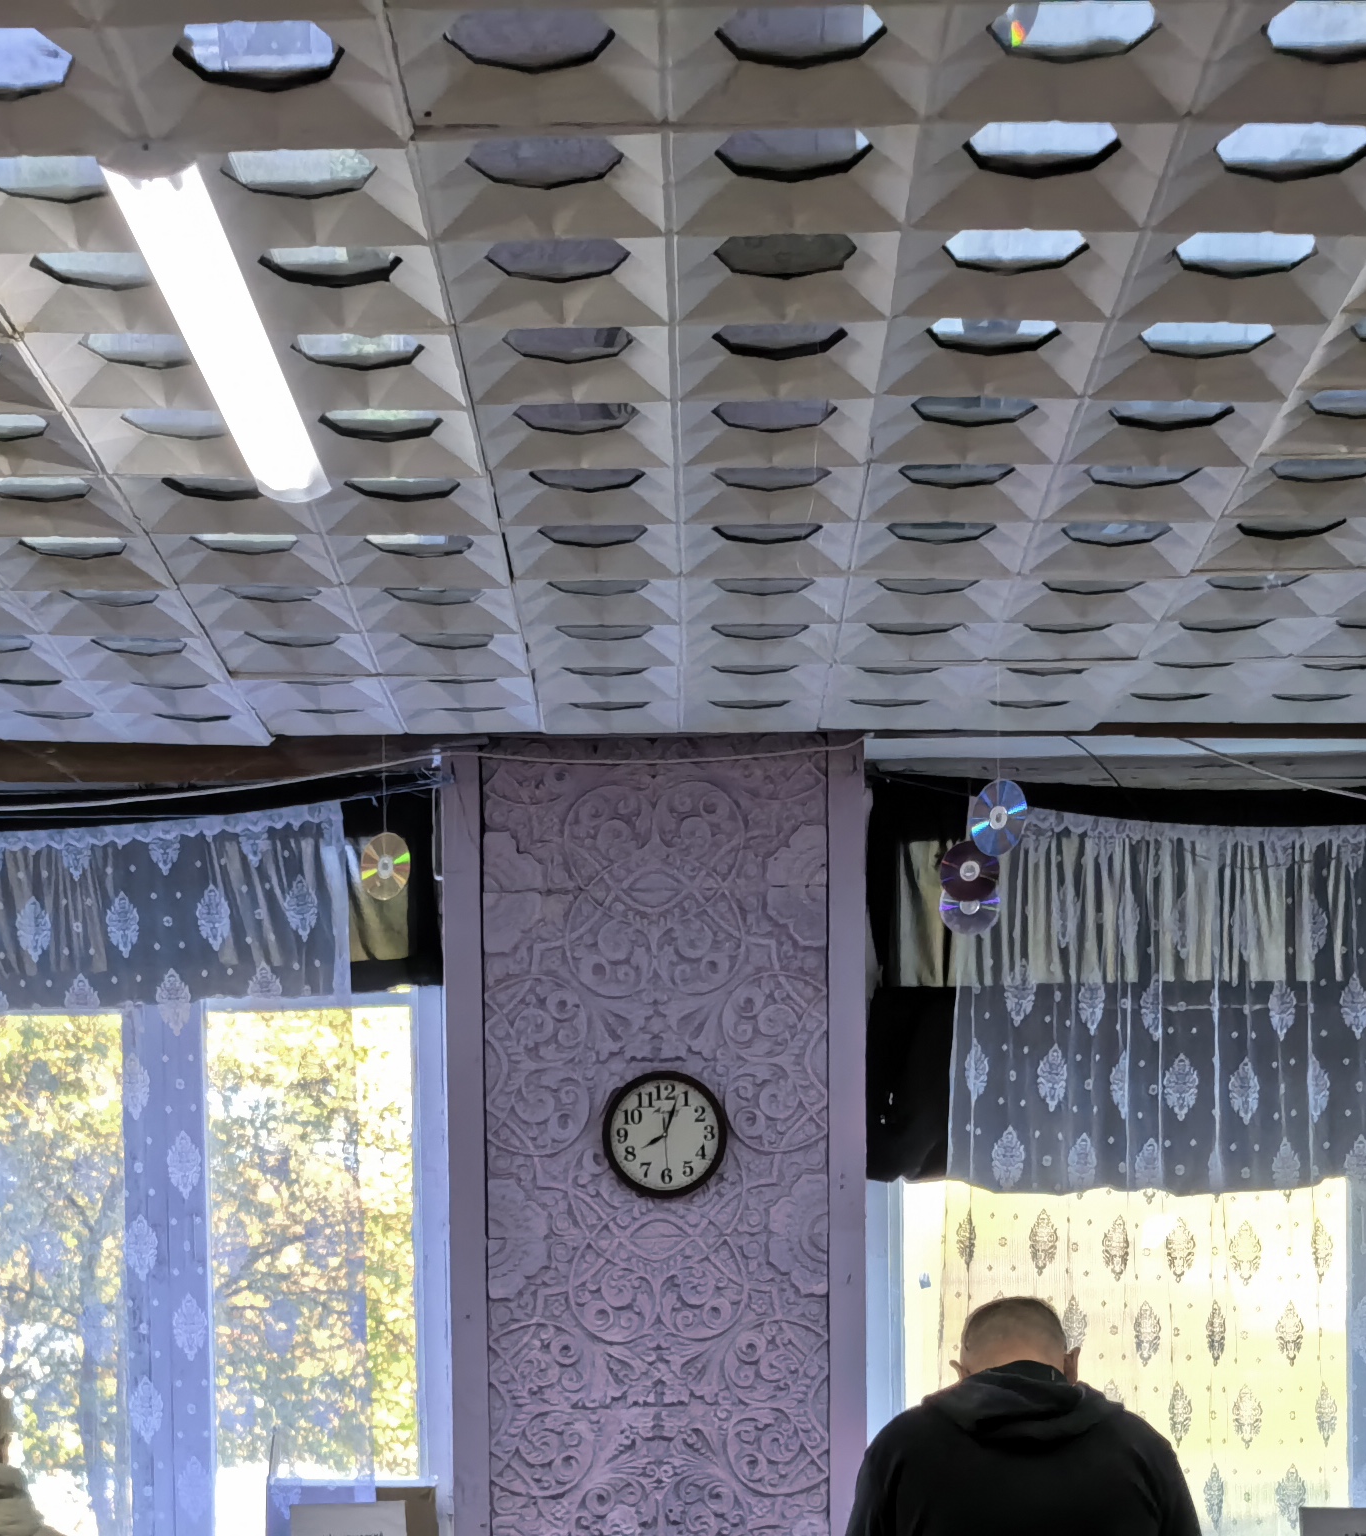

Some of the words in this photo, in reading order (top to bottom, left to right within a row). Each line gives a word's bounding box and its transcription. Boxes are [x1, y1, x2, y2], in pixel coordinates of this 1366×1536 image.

[635, 1091, 655, 1108] 11
[654, 1084, 675, 1101] 12
[681, 1090, 691, 1107] 1
[622, 1108, 642, 1125] 10
[694, 1106, 706, 1122] 2
[616, 1127, 628, 1144] 9
[704, 1125, 715, 1141] 3
[623, 1145, 636, 1162] 8
[695, 1141, 707, 1160] 4
[639, 1162, 652, 1178] 7
[661, 1168, 673, 1185] 6
[682, 1161, 694, 1177] 5
